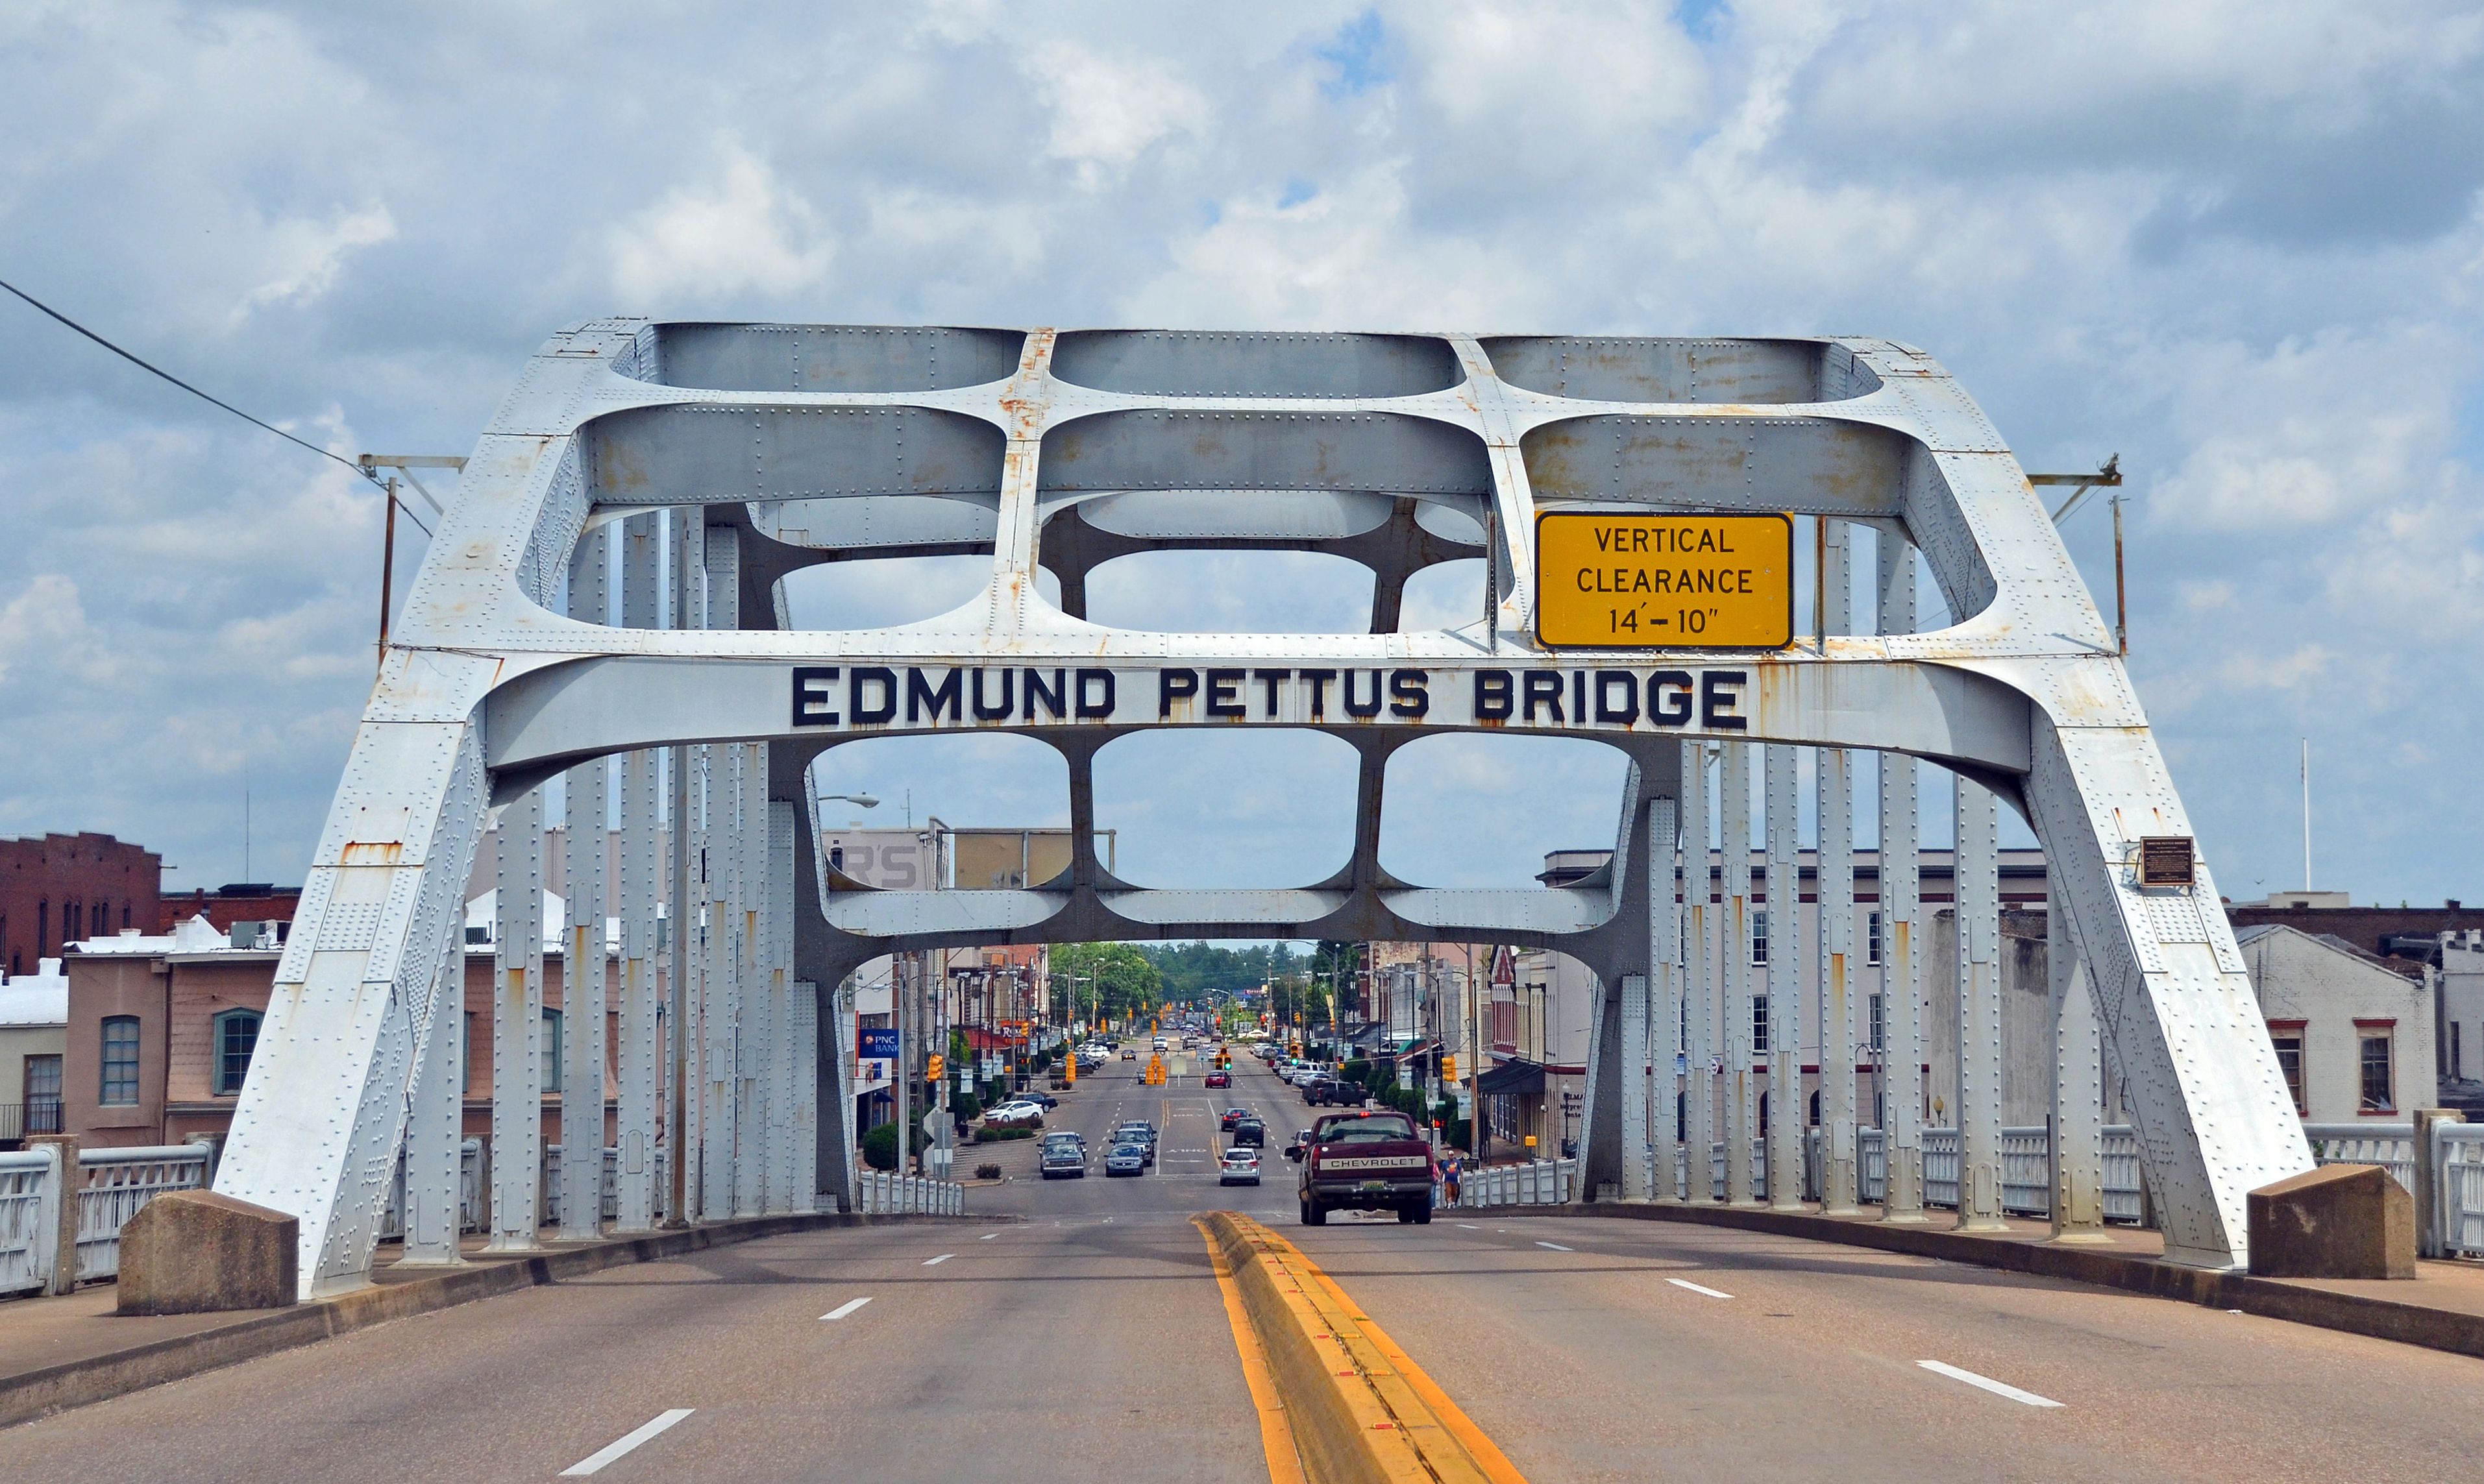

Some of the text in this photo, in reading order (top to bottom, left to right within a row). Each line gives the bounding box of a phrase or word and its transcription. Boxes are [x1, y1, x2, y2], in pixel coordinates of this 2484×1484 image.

[1594, 528, 1734, 553] VERTICAL
[1577, 567, 1753, 594] CLEARANCE
[793, 666, 1748, 729] EDMUND PETTUS BRIDGE
[824, 845, 916, 888] R'S
[875, 1036, 895, 1044] PNC
[1331, 1158, 1416, 1167] CHEVROLET
